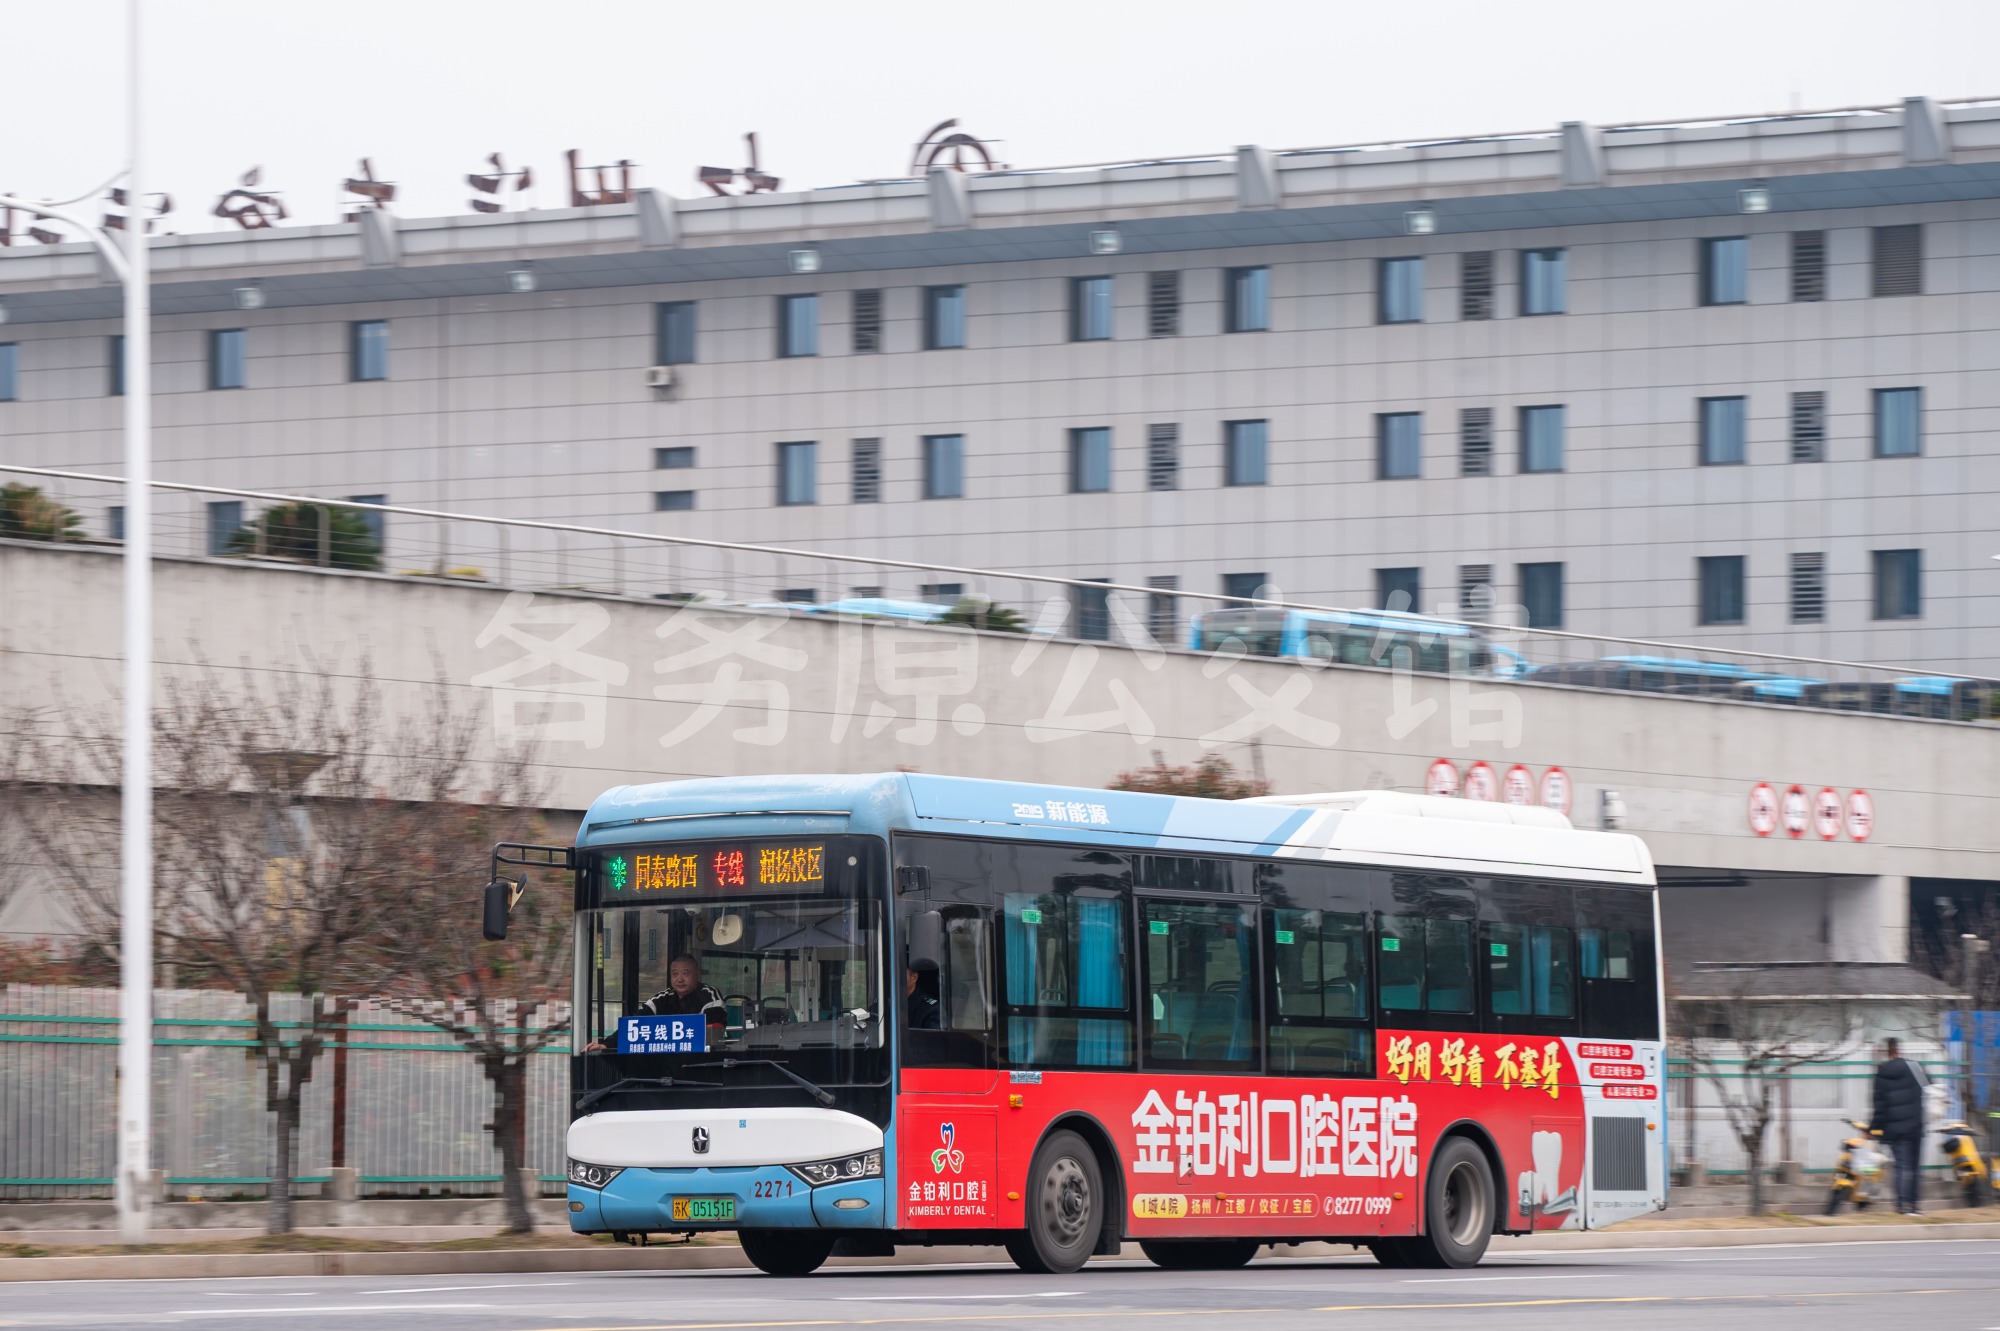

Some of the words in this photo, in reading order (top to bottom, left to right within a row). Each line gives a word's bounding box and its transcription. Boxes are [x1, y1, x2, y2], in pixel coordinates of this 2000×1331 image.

[1045, 800, 1110, 825] 新能源
[635, 853, 698, 890] 同泰路西
[713, 850, 745, 886] 专线
[759, 846, 823, 885] 润扬校区
[1385, 1035, 1432, 1085] 好用
[1438, 1037, 1485, 1089] 好看
[1494, 1041, 1563, 1100] 不塞牙
[1131, 1089, 1418, 1178] 金铂利口腔医院
[754, 1180, 793, 1198] 2271
[908, 1181, 979, 1201] 金铂利口腔
[908, 1205, 951, 1216] KIMBERLY
[954, 1205, 987, 1215] DENTAL
[1141, 1197, 1179, 1215] 1城4院
[1191, 1197, 1211, 1214] 扬州
[1225, 1197, 1245, 1214] 江都
[1259, 1197, 1279, 1214] 仪征
[1292, 1197, 1313, 1214] 宝应
[1334, 1196, 1364, 1215] 8277
[1365, 1196, 1391, 1215] 0999
